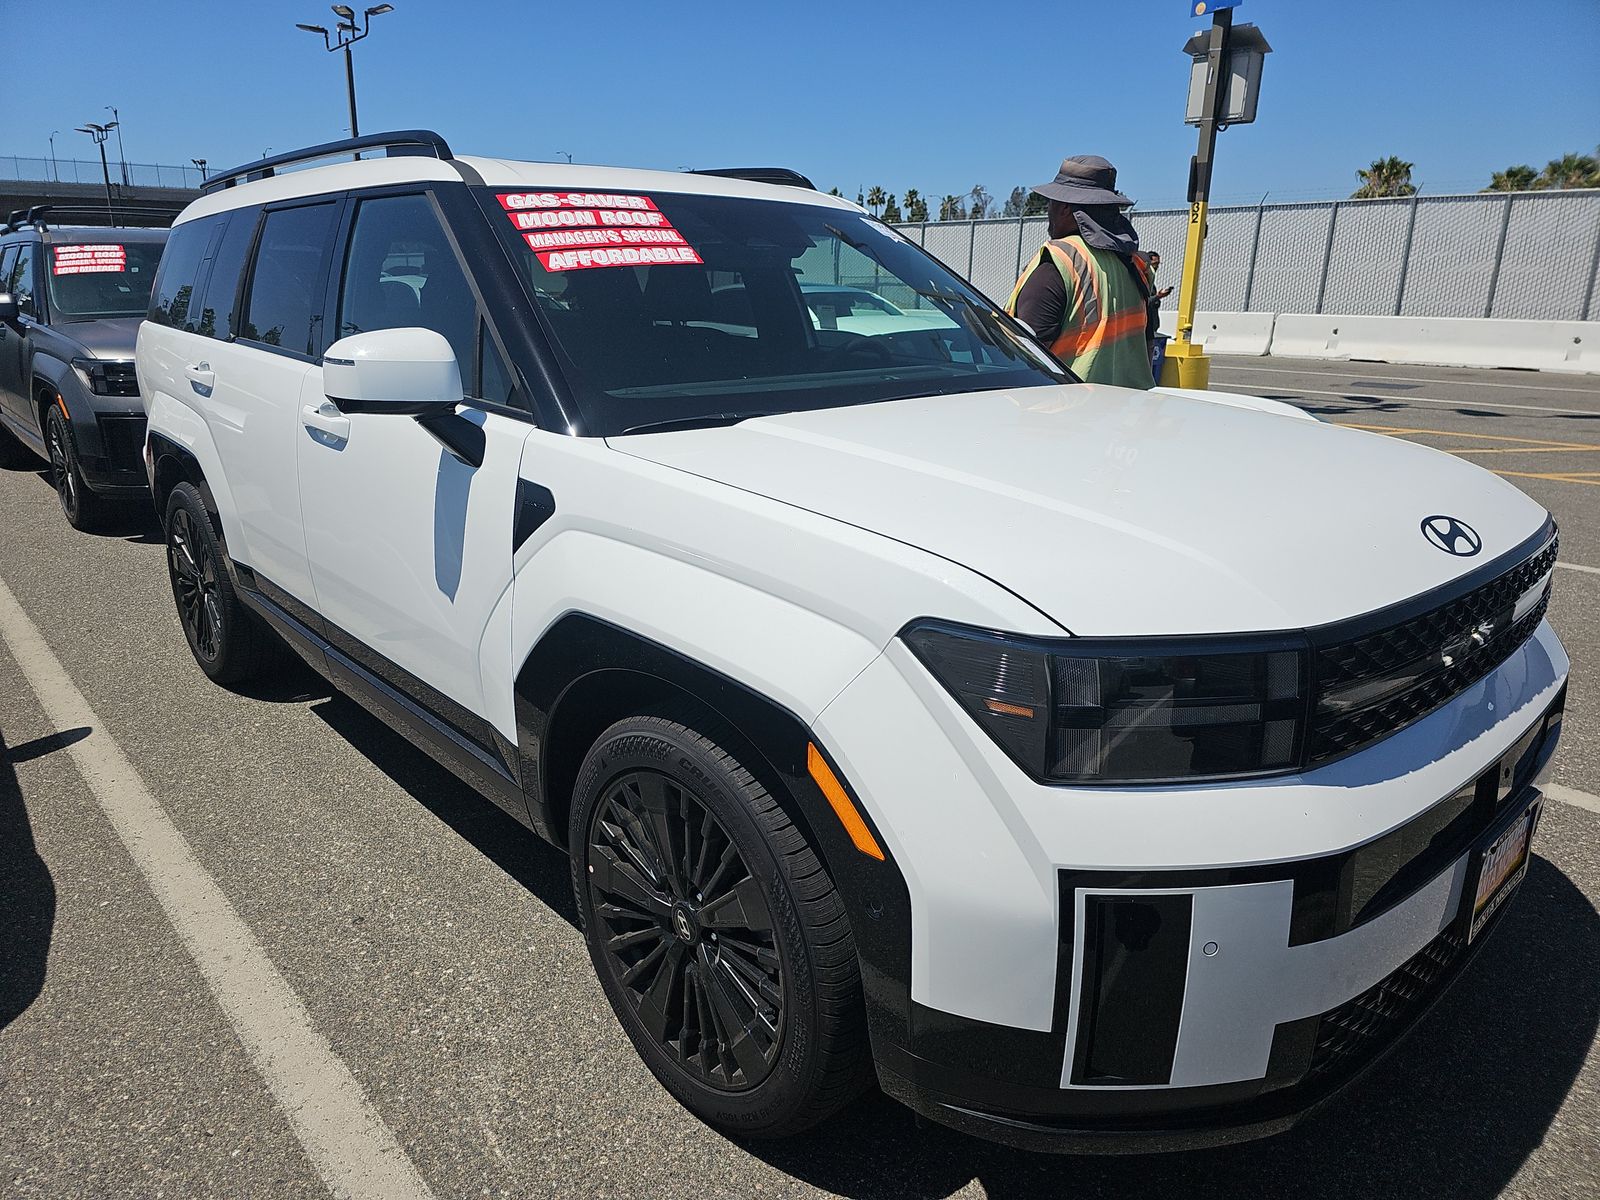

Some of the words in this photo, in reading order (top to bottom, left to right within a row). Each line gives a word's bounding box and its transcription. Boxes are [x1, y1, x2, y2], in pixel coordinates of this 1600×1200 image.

[506, 193, 648, 210] GAS-SAVER
[516, 210, 597, 228] MOON
[600, 210, 663, 227] ROOF
[527, 230, 622, 248] MANAGER'S
[620, 229, 684, 243] SPECIAL
[548, 247, 698, 270] AFFORDABLE
